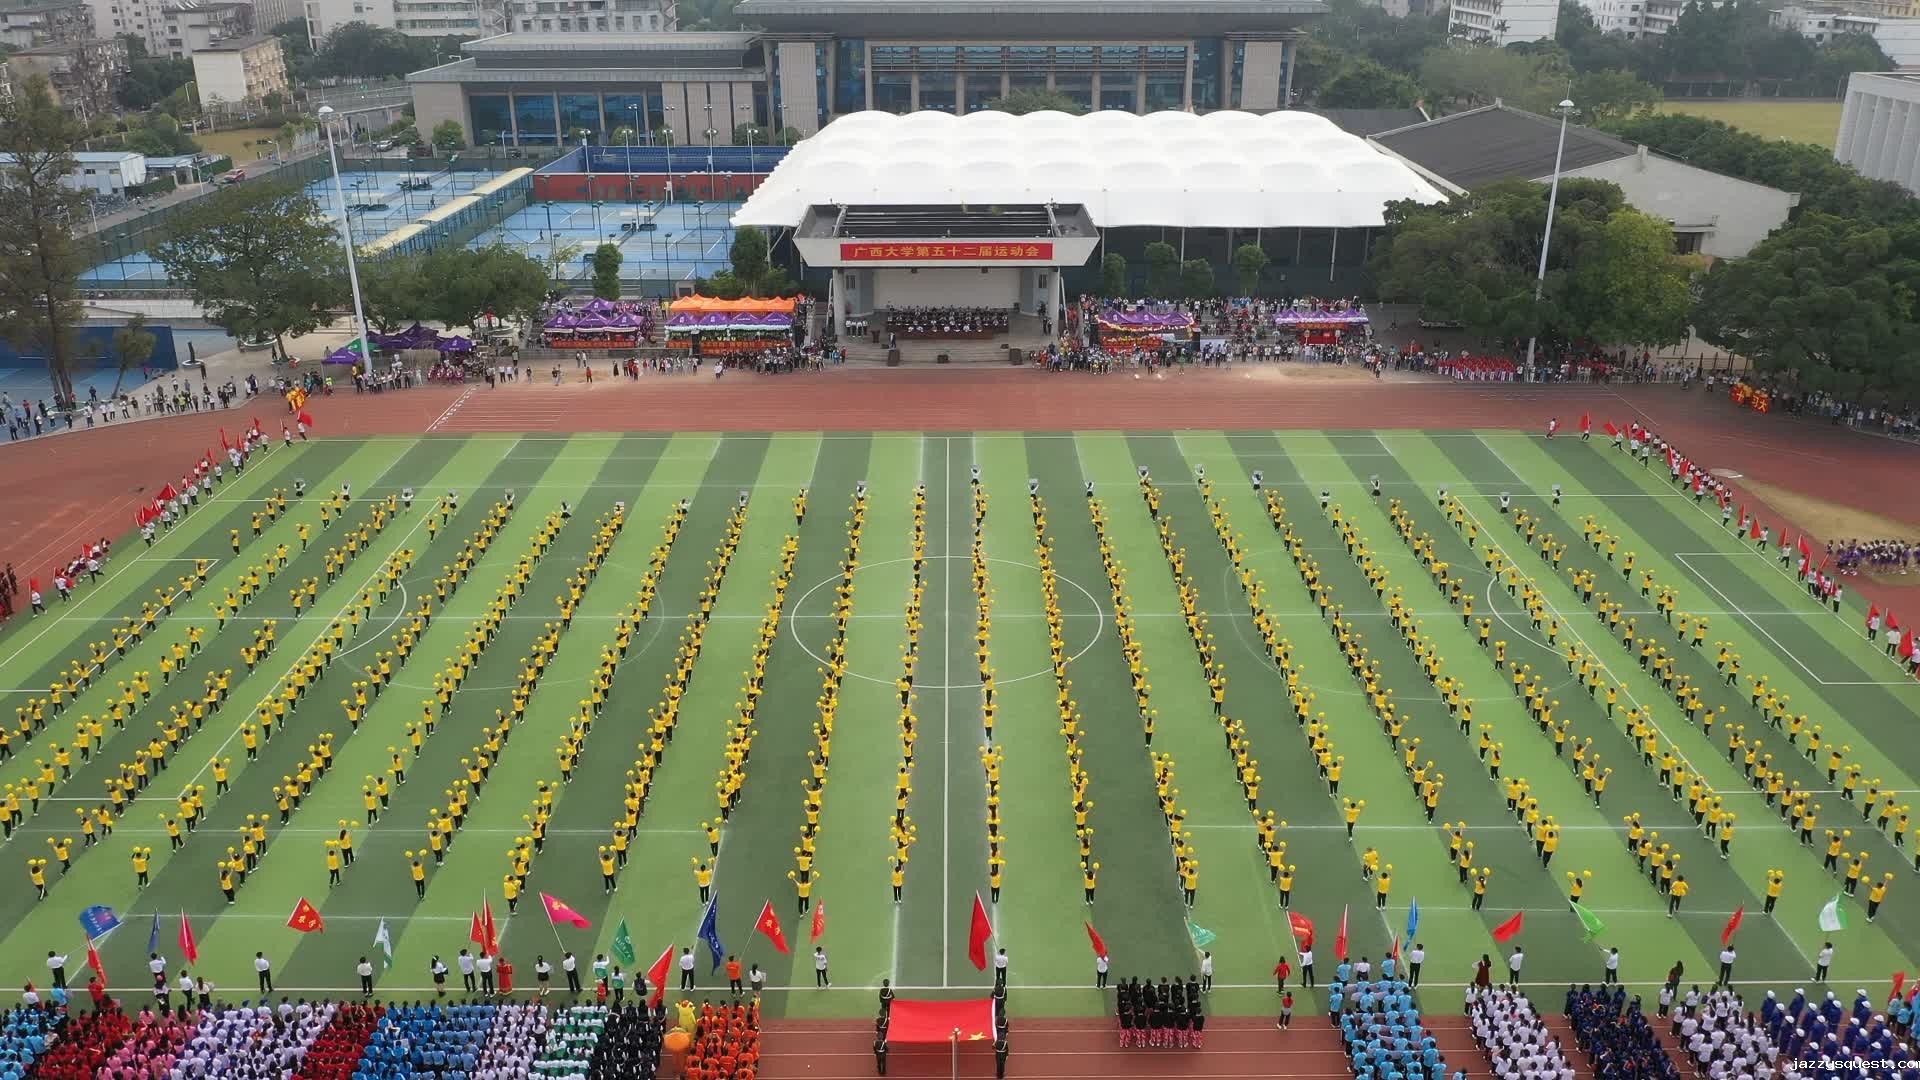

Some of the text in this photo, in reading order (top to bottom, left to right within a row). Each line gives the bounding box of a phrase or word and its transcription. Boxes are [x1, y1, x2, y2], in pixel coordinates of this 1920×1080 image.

[853, 246, 1039, 257] 广西大学第五十二届运动会
